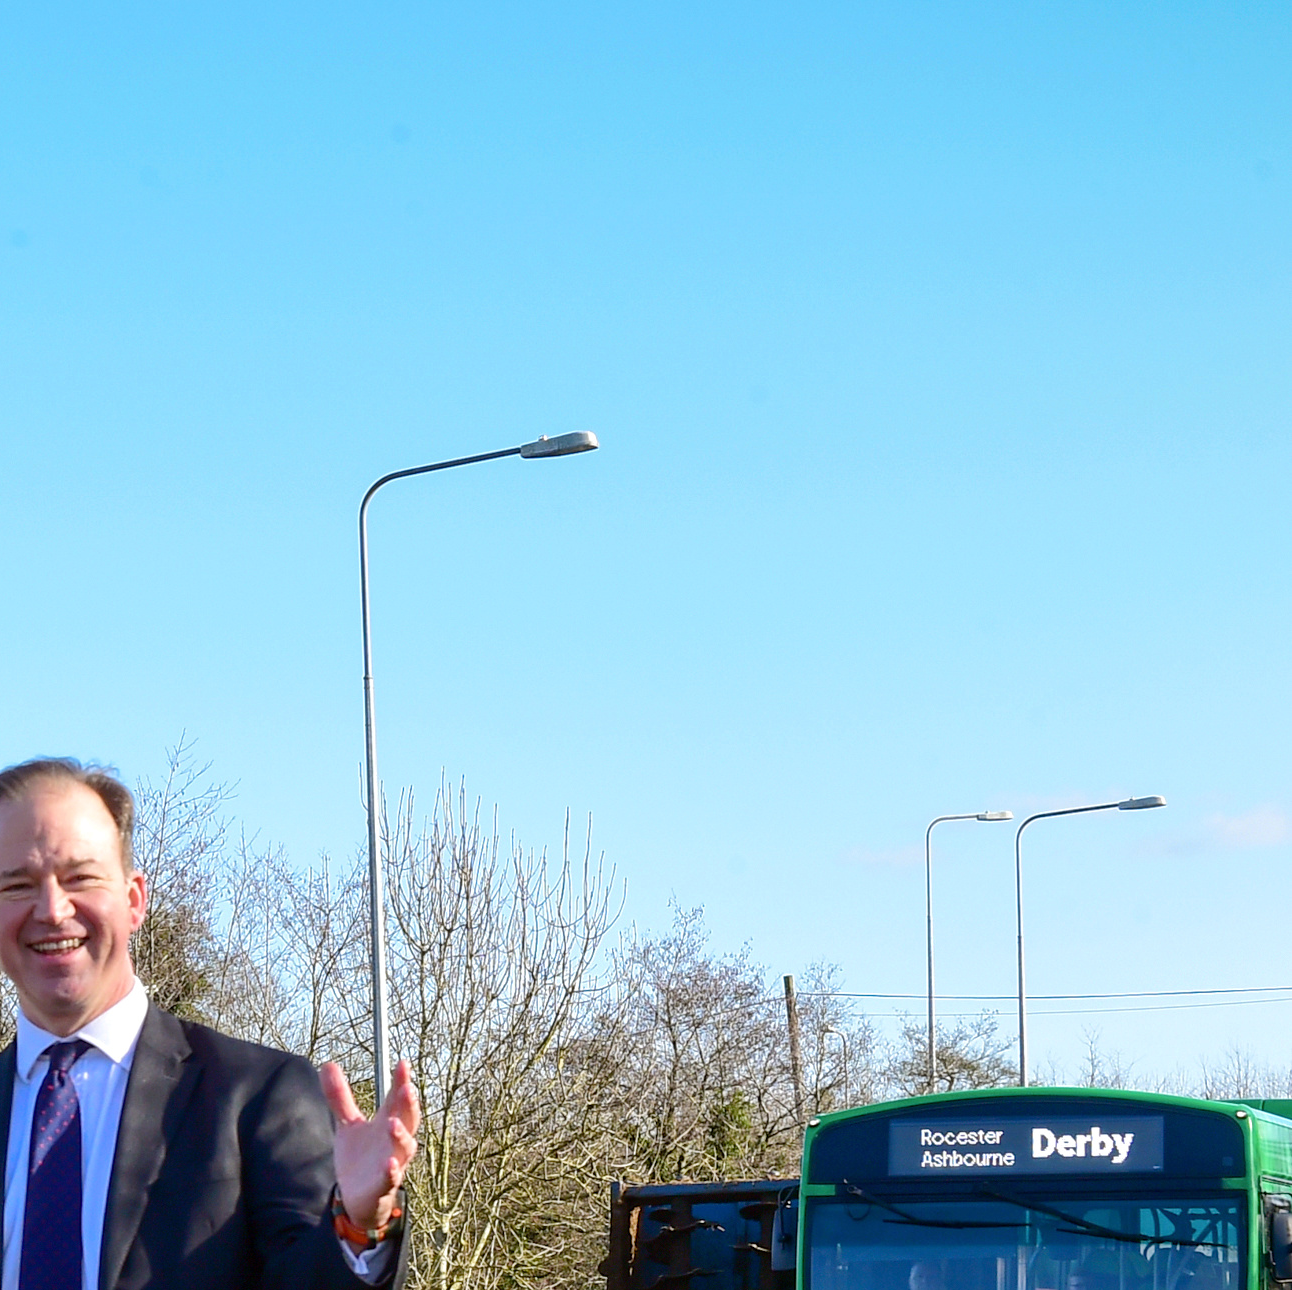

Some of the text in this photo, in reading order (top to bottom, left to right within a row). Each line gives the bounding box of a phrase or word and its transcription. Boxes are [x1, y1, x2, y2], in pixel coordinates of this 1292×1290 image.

[920, 1126, 1133, 1164] Rocester Derby
[920, 1151, 1016, 1168] Ashbourne
